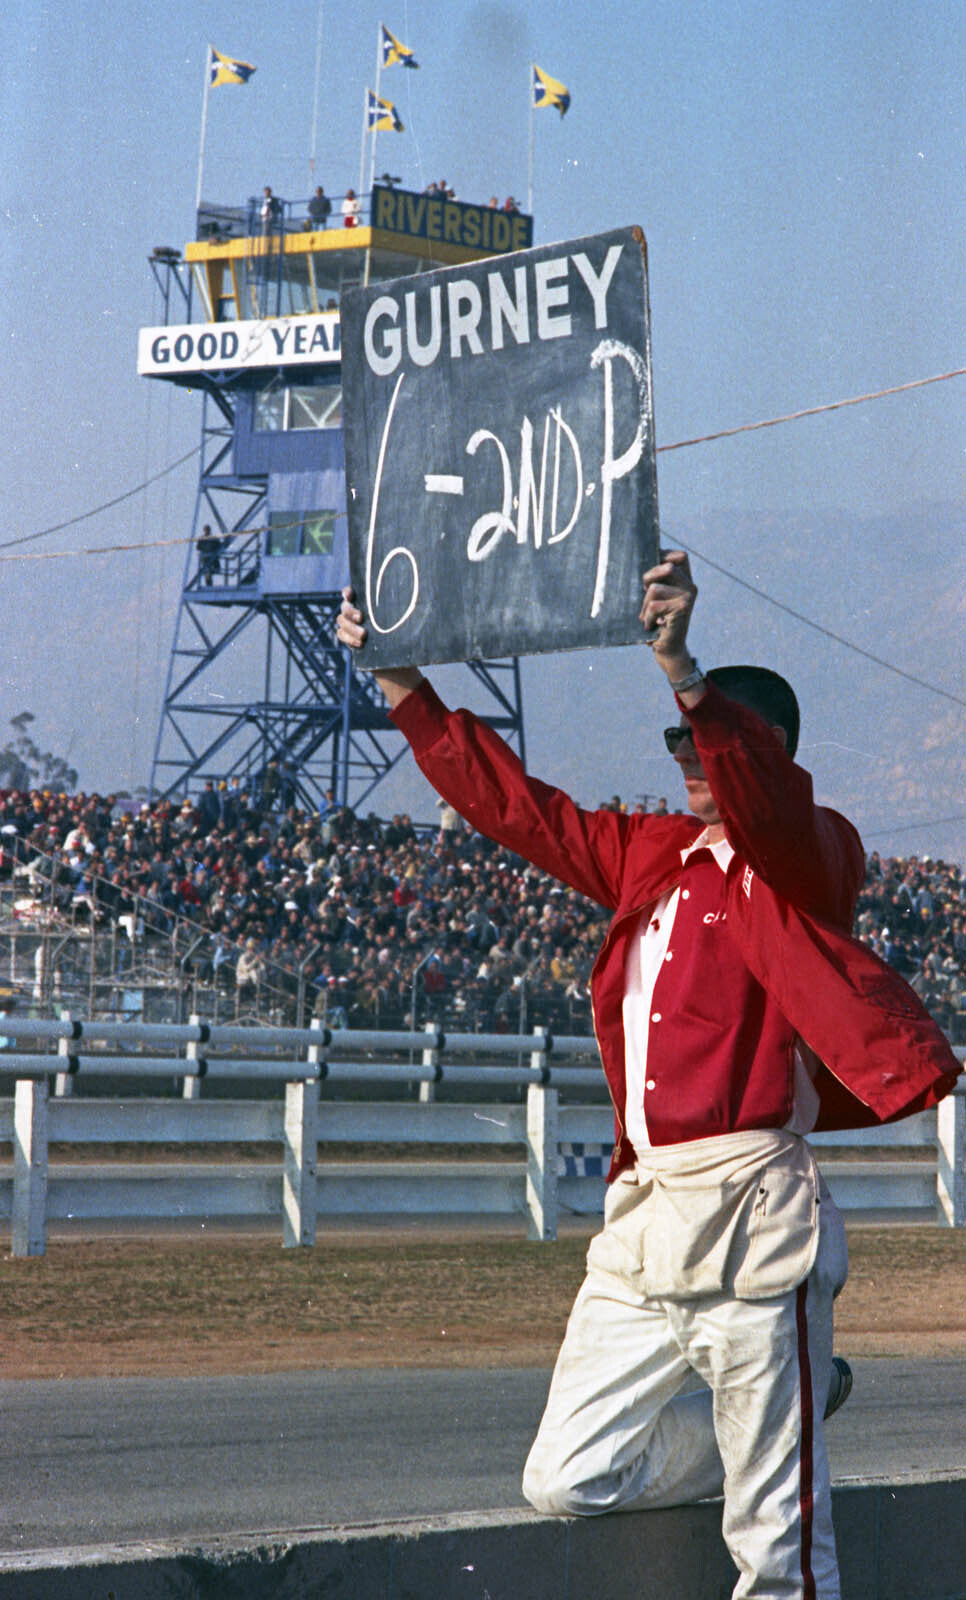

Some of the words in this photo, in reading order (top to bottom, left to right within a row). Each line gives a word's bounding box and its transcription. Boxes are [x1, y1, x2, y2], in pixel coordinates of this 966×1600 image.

[376, 189, 529, 251] RIVERSIDE
[364, 245, 624, 376] GURNEY
[151, 331, 239, 363] GOOD
